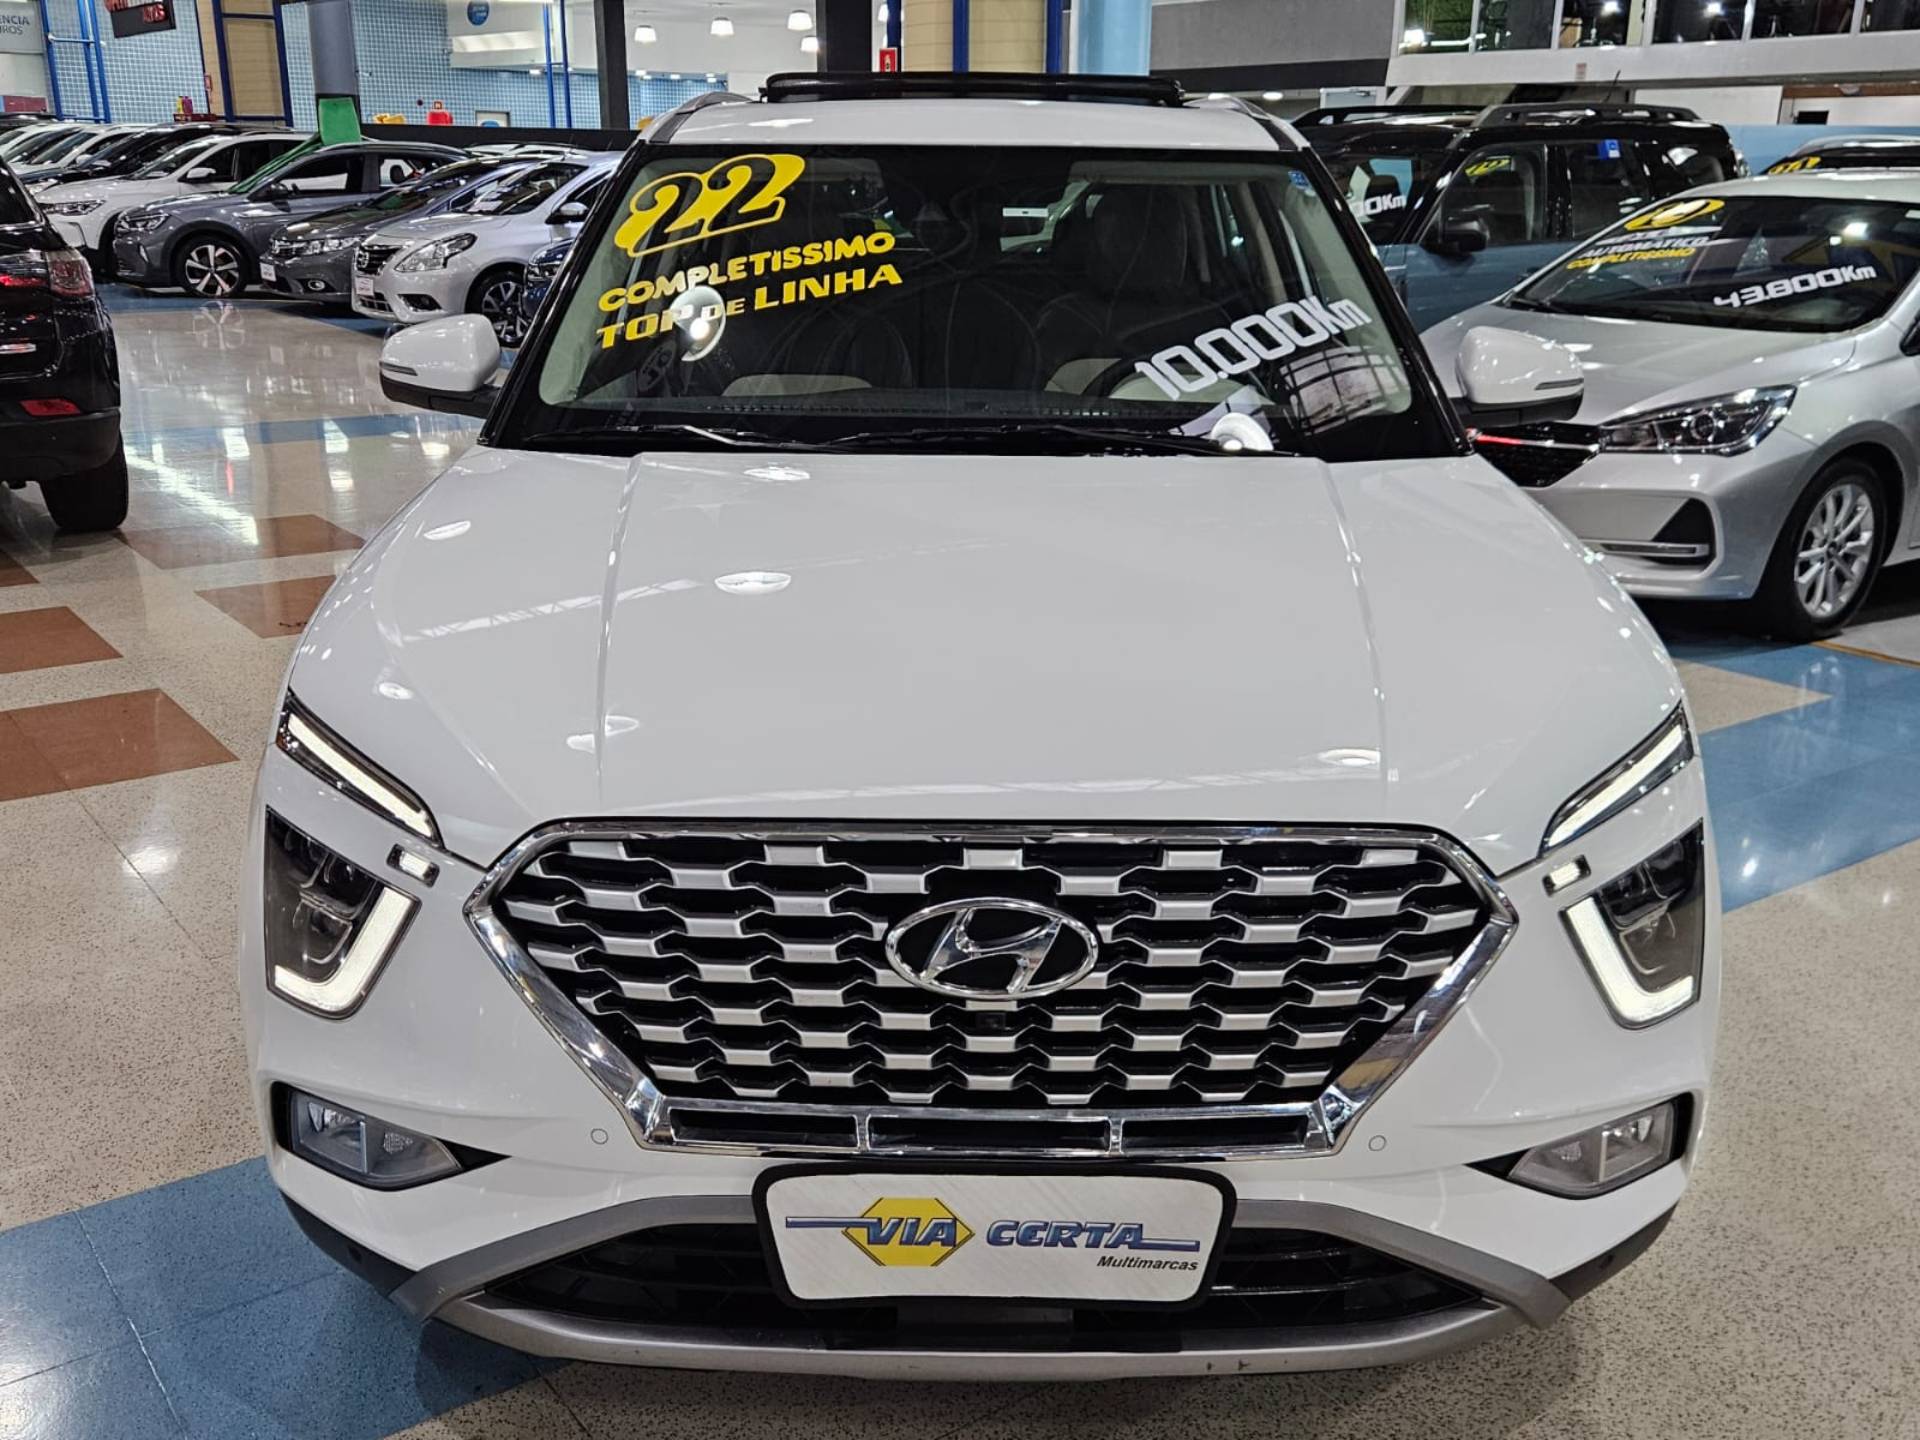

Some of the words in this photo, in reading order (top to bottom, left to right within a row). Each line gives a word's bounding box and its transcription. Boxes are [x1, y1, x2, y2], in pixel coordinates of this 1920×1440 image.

[614, 153, 806, 258] 22
[596, 304, 694, 349] TOP
[700, 298, 746, 322] DE
[754, 263, 903, 311] LINHA
[1134, 296, 1373, 401] 10.000Km
[860, 1217, 957, 1247] VIA
[986, 1219, 1144, 1250] CERTA
[1096, 1255, 1199, 1271] Multimarcas
